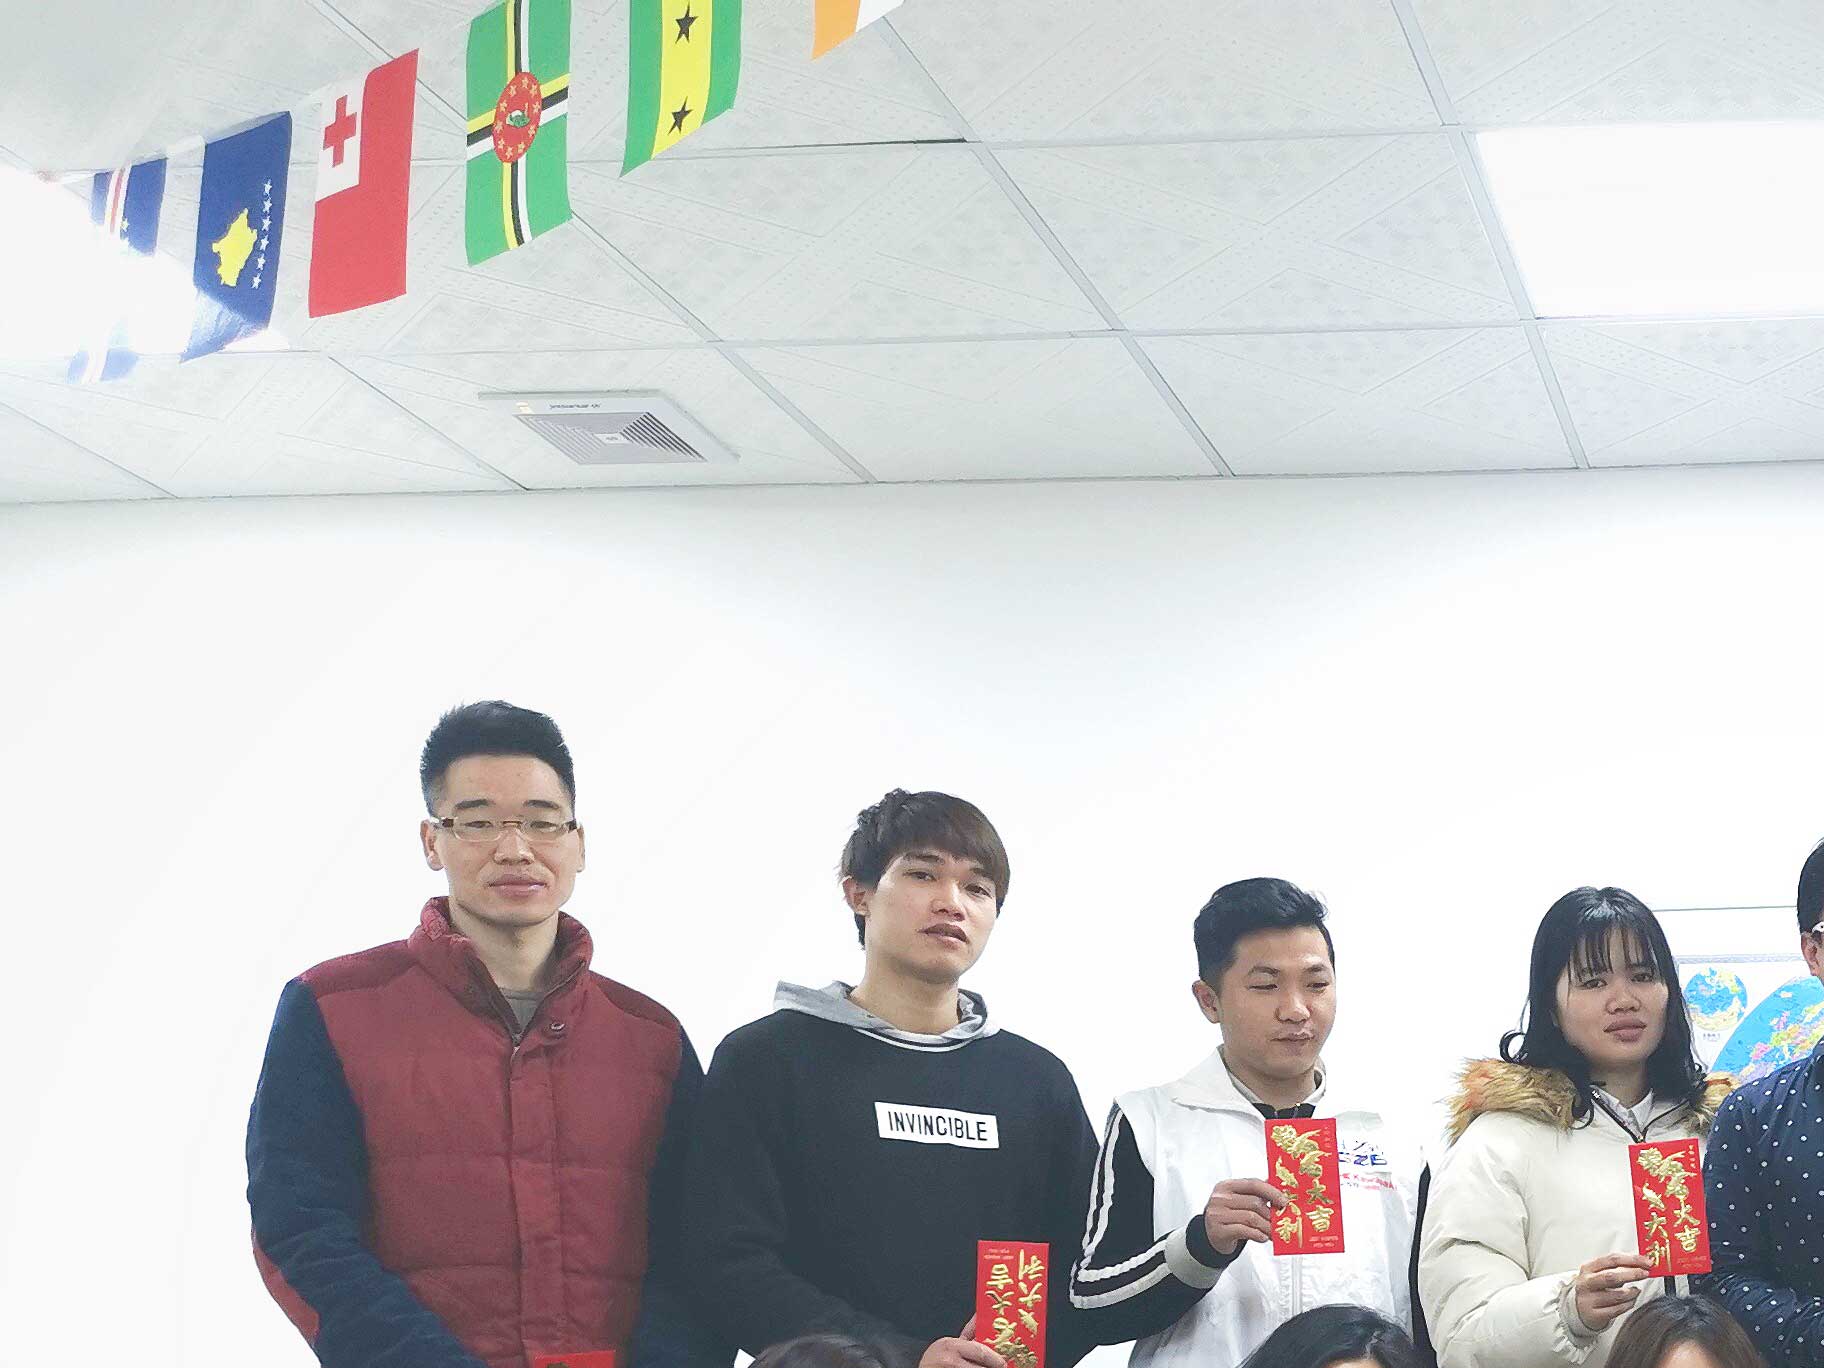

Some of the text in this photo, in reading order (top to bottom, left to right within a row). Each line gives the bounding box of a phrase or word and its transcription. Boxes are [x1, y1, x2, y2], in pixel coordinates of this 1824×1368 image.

[888, 1110, 988, 1141] INVINCIBLE
[1306, 1179, 1334, 1232] 大吉
[1673, 1198, 1701, 1253] 大吉
